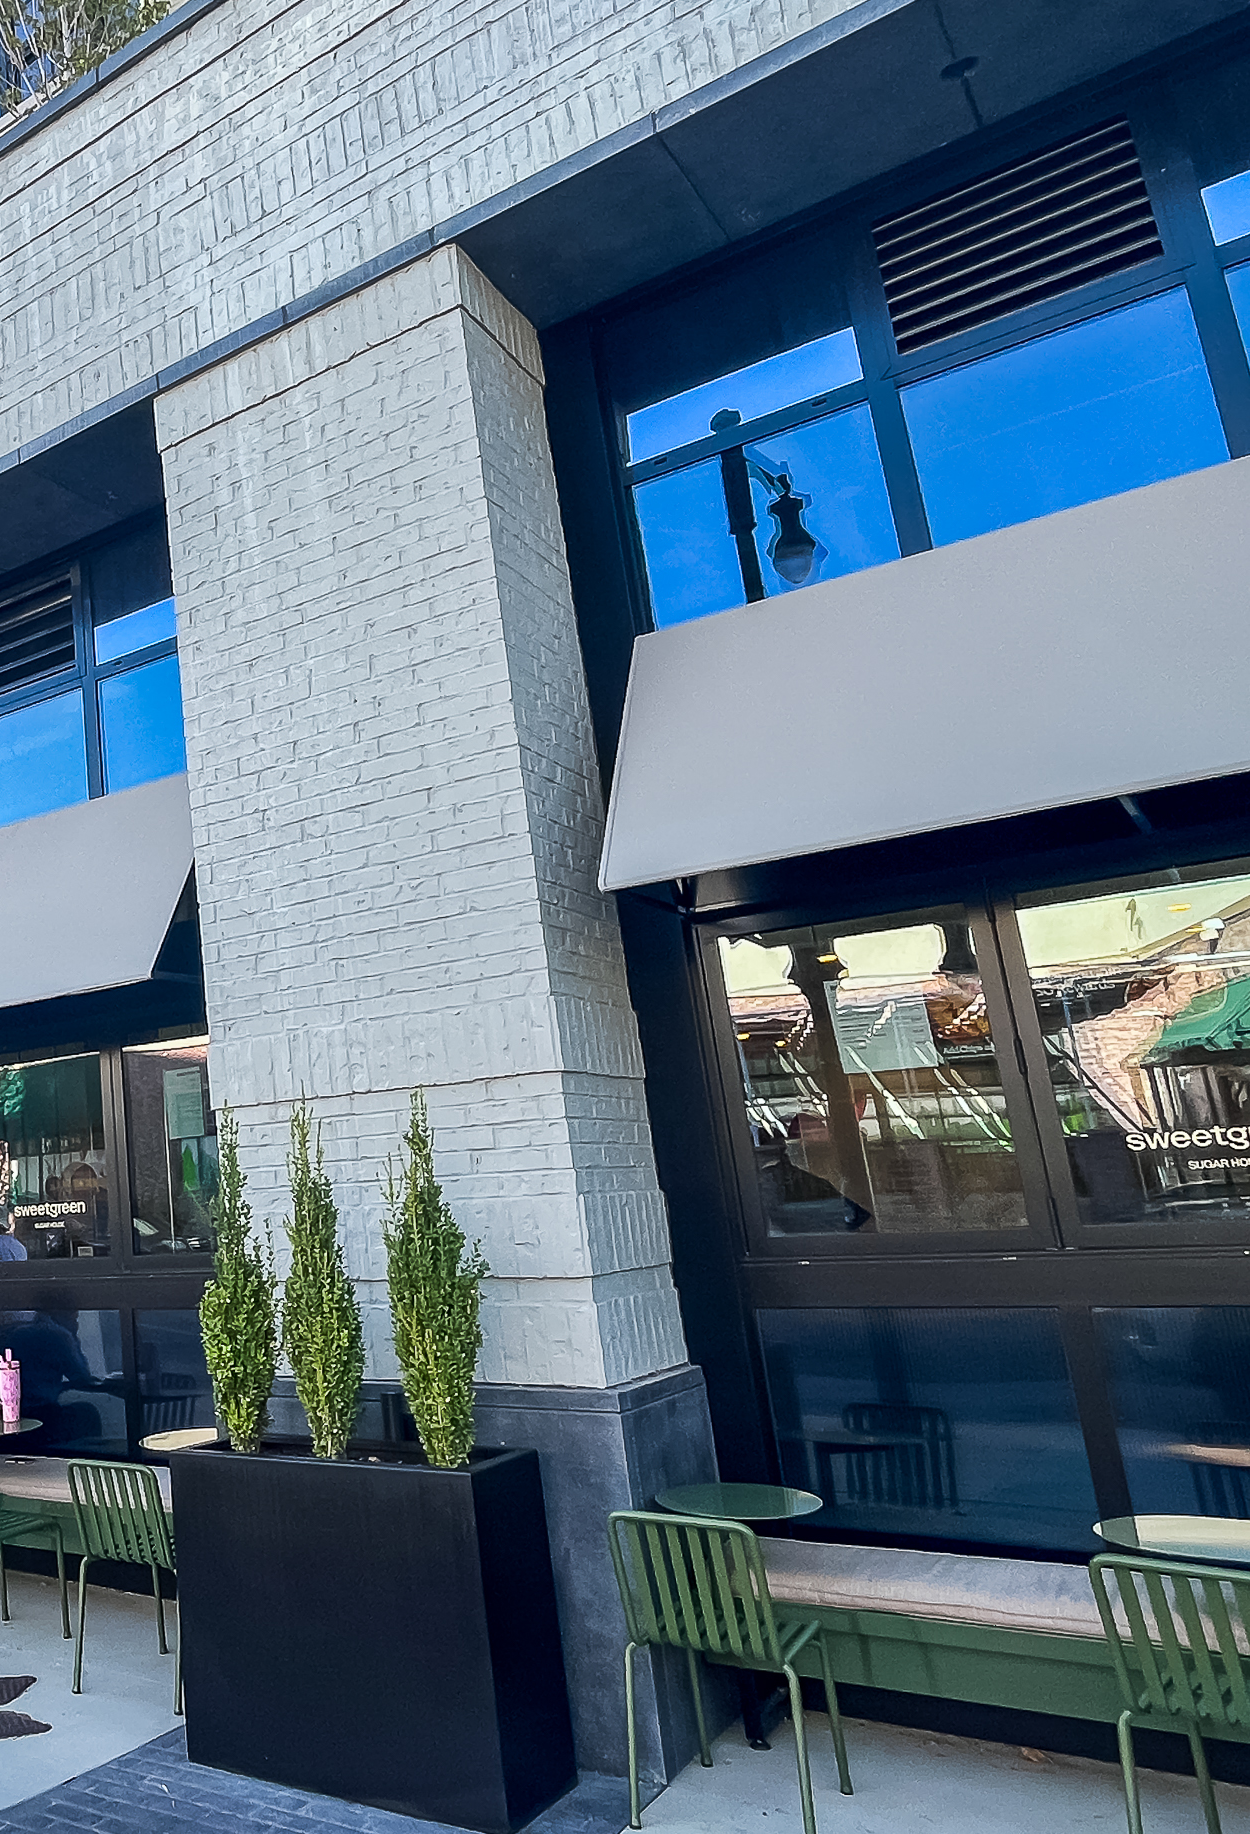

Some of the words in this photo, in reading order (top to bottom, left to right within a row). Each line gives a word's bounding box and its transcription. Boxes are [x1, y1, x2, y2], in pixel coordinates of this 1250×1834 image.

[1125, 1125, 1250, 1151] sweetg
[1188, 1158, 1229, 1170] SUGAR
[14, 1201, 86, 1218] sweetgreen
